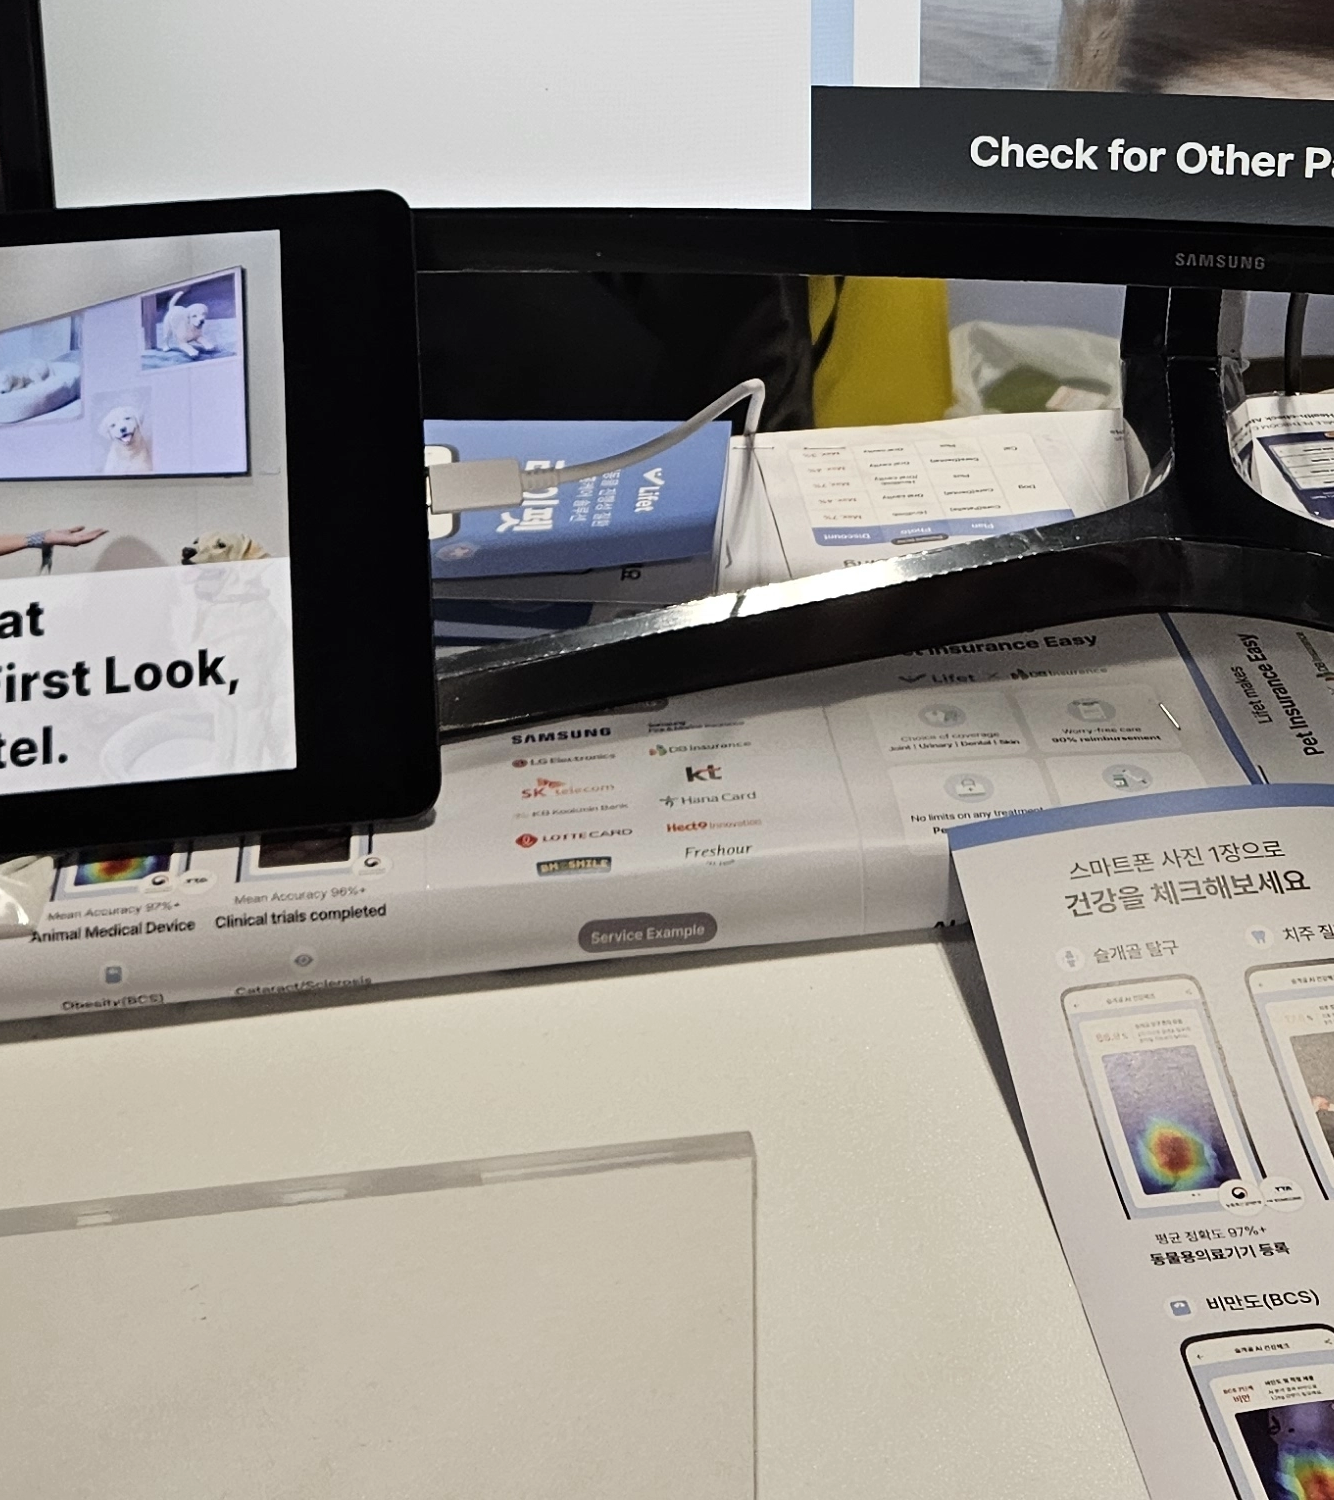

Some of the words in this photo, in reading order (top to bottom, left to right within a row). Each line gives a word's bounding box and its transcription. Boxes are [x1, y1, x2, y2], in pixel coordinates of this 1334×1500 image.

[969, 134, 1100, 171] Check
[1107, 137, 1166, 173] for
[1175, 141, 1295, 178] Other
[1175, 251, 1266, 271] SAMSUNG
[634, 485, 660, 513] Lifet
[1042, 634, 1098, 650] Easy
[1237, 633, 1268, 662] Easy
[104, 647, 242, 699] Look,
[931, 671, 976, 684] Lifet
[1230, 665, 1259, 699] makes
[1258, 663, 1309, 730] Insurance
[1248, 699, 1273, 724] Lifet
[511, 727, 612, 745] SAMSUNG
[900, 733, 938, 742] Choice
[955, 731, 1000, 741] coverage
[1061, 726, 1117, 736] Worry-free
[1080, 735, 1162, 743] reimbursement
[1296, 731, 1325, 756] Pet
[550, 752, 616, 765] Electronics
[685, 764, 723, 783] kt
[521, 787, 547, 799] SK
[554, 782, 616, 797] telecom
[681, 794, 719, 805] Hana
[721, 790, 758, 802] Card
[911, 813, 926, 823] No
[927, 811, 955, 821] limits
[972, 809, 993, 819] any
[685, 844, 754, 859] Freshour
[1069, 851, 1155, 881] 스마트폰
[1161, 845, 1205, 869] 사진
[1207, 839, 1287, 864] 1장으로
[234, 893, 268, 905] Mean
[270, 888, 328, 902] Accuracy
[330, 885, 367, 898] 96%+
[1064, 884, 1146, 918] 건강을
[1150, 869, 1312, 906] 체크해보세요
[84, 903, 143, 918] Accuracy
[215, 914, 269, 930] Clinical
[271, 908, 307, 925] trials
[309, 904, 387, 923] completed
[29, 927, 82, 944] Animal
[85, 921, 143, 939] Medical
[146, 917, 196, 934] Device
[591, 929, 643, 944] Service
[646, 923, 706, 942] Example
[1282, 925, 1316, 943] 치주
[1092, 943, 1143, 965] 슬개골
[1144, 938, 1180, 958] 탈구
[234, 975, 373, 996] Cataract/Sclerosis
[1154, 1231, 1182, 1246] 평균
[1183, 1227, 1226, 1243] 정확도
[1227, 1225, 1267, 1240] 97%+
[1149, 1244, 1257, 1267] 동물용의료기기
[1258, 1241, 1291, 1257] 등록
[1206, 1288, 1321, 1313] 비만도(BCS)
